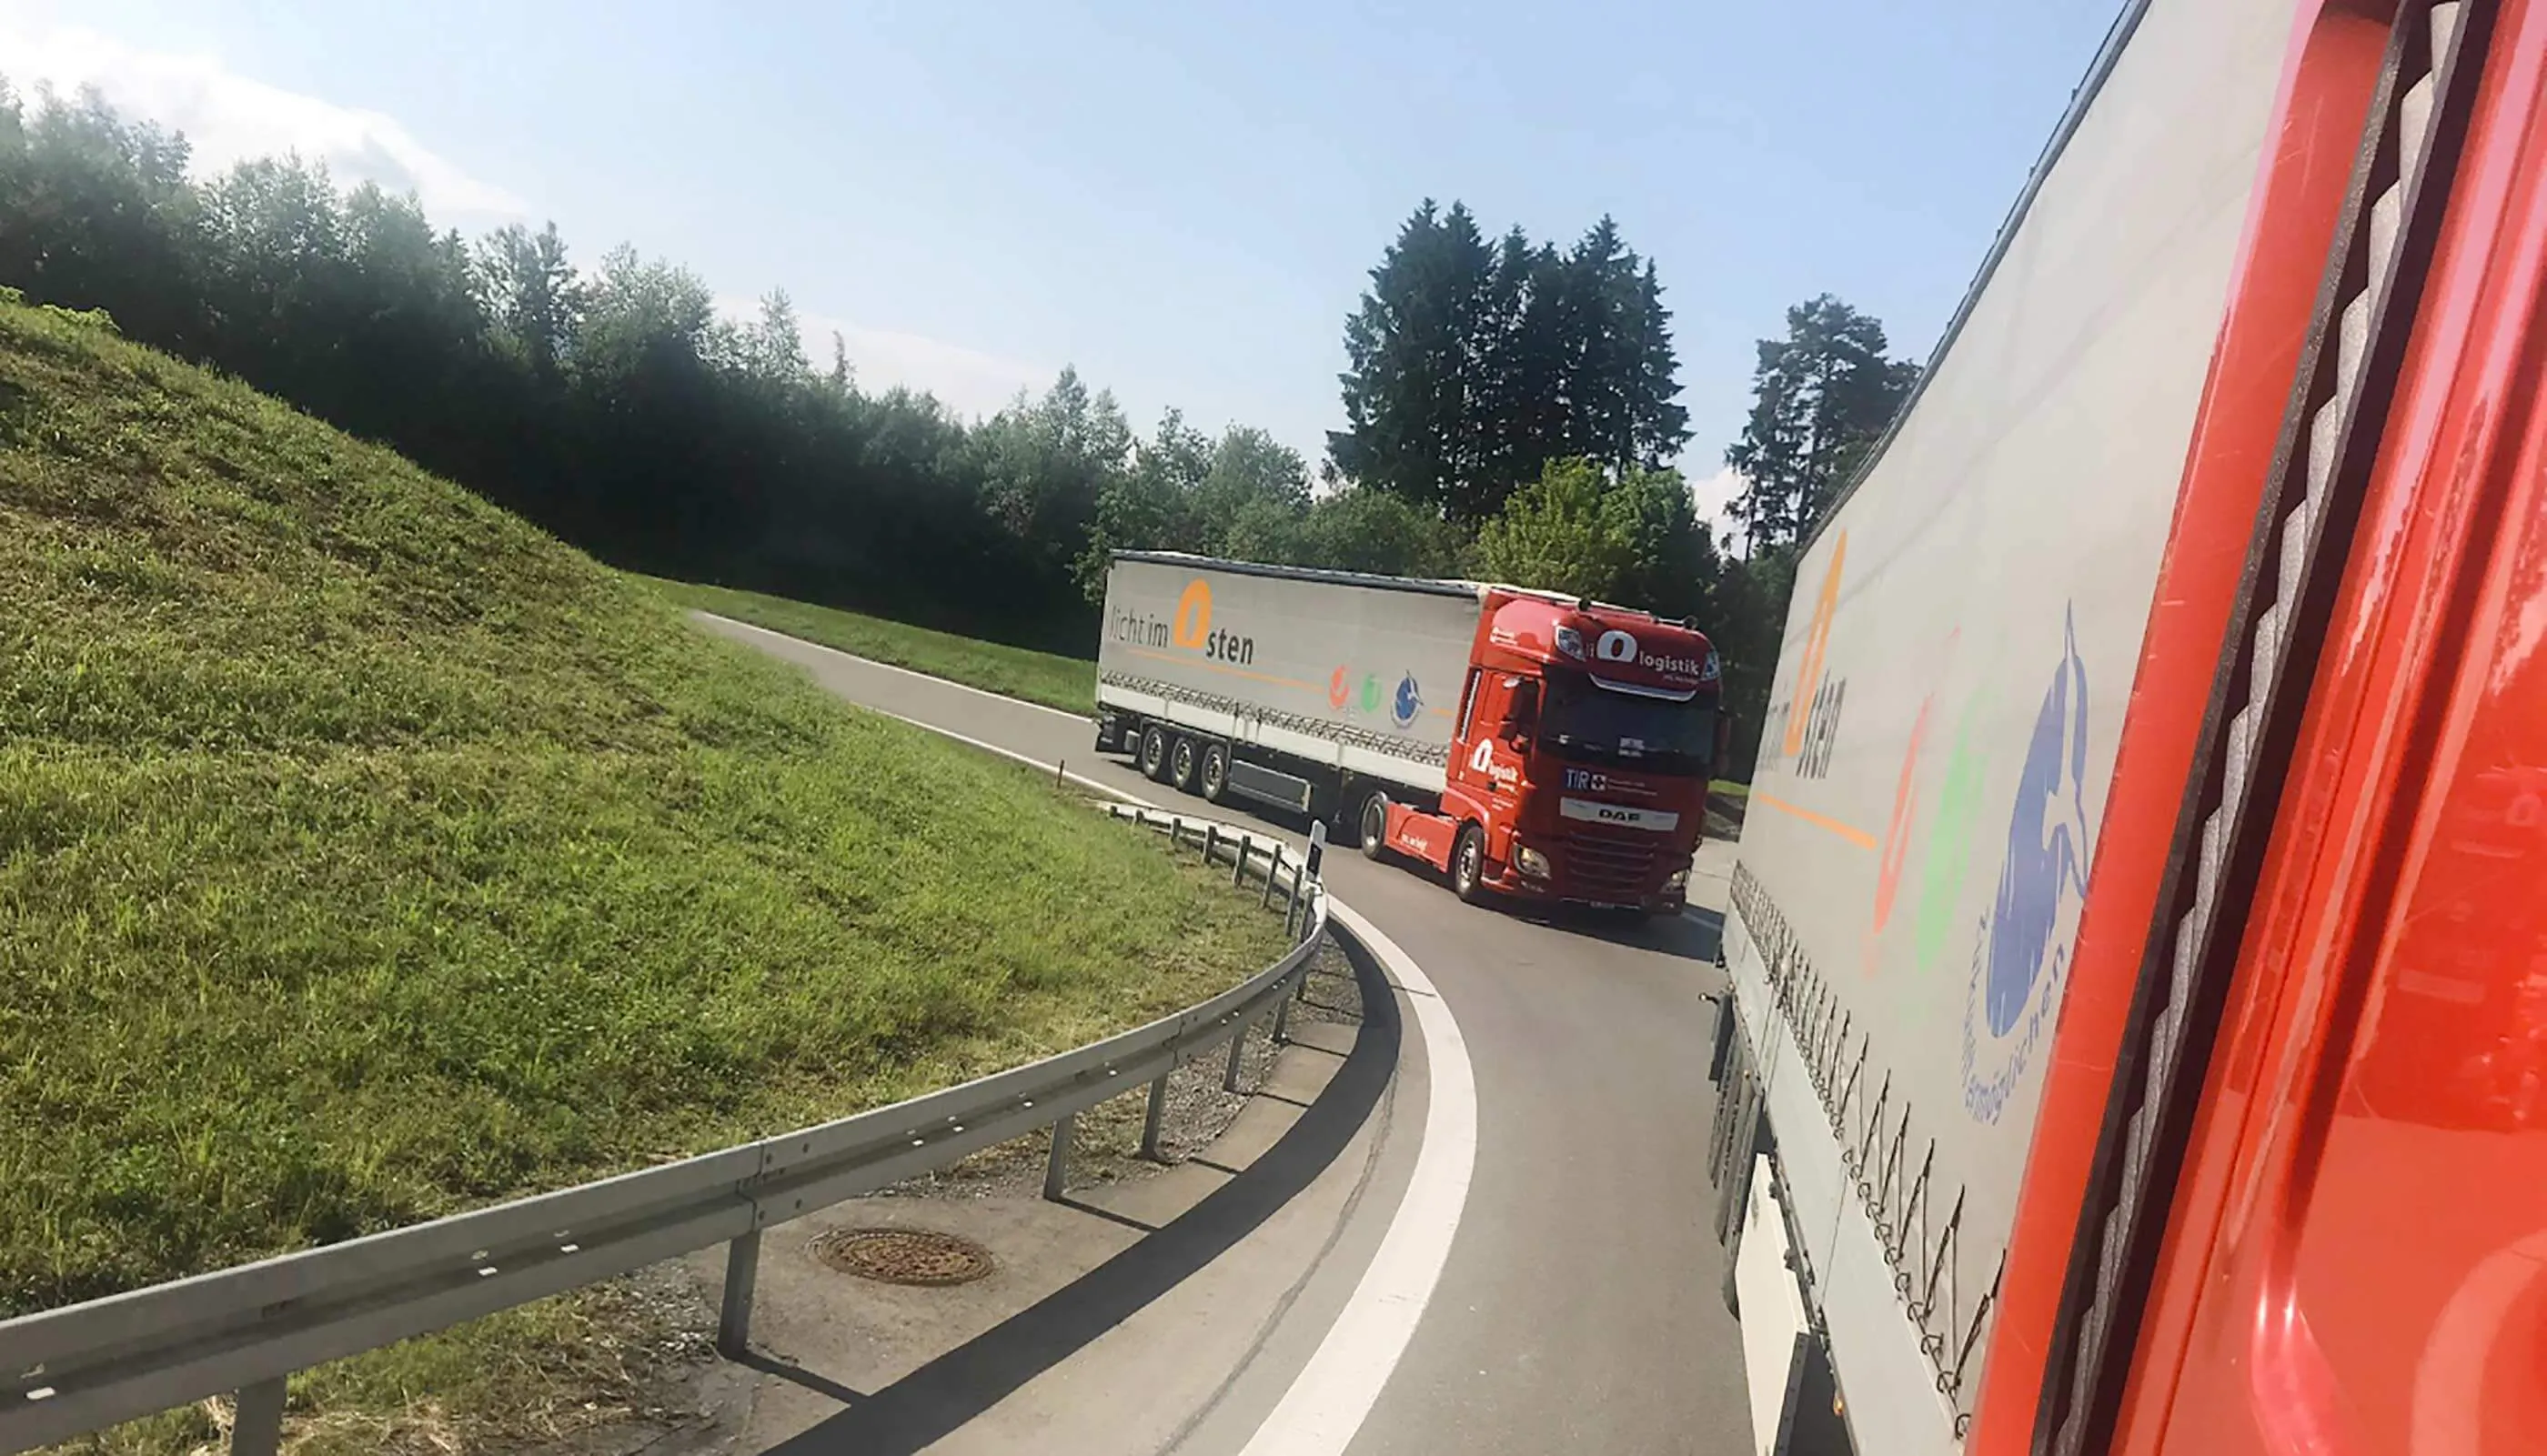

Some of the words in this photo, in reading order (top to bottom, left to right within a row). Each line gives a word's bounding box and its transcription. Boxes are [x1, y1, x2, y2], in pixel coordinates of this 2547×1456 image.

[1110, 606, 1144, 644] licht
[1147, 613, 1168, 648] im
[1639, 650, 1700, 676] logistik
[1565, 768, 1591, 790] TIR
[1598, 808, 1641, 821] DAF
